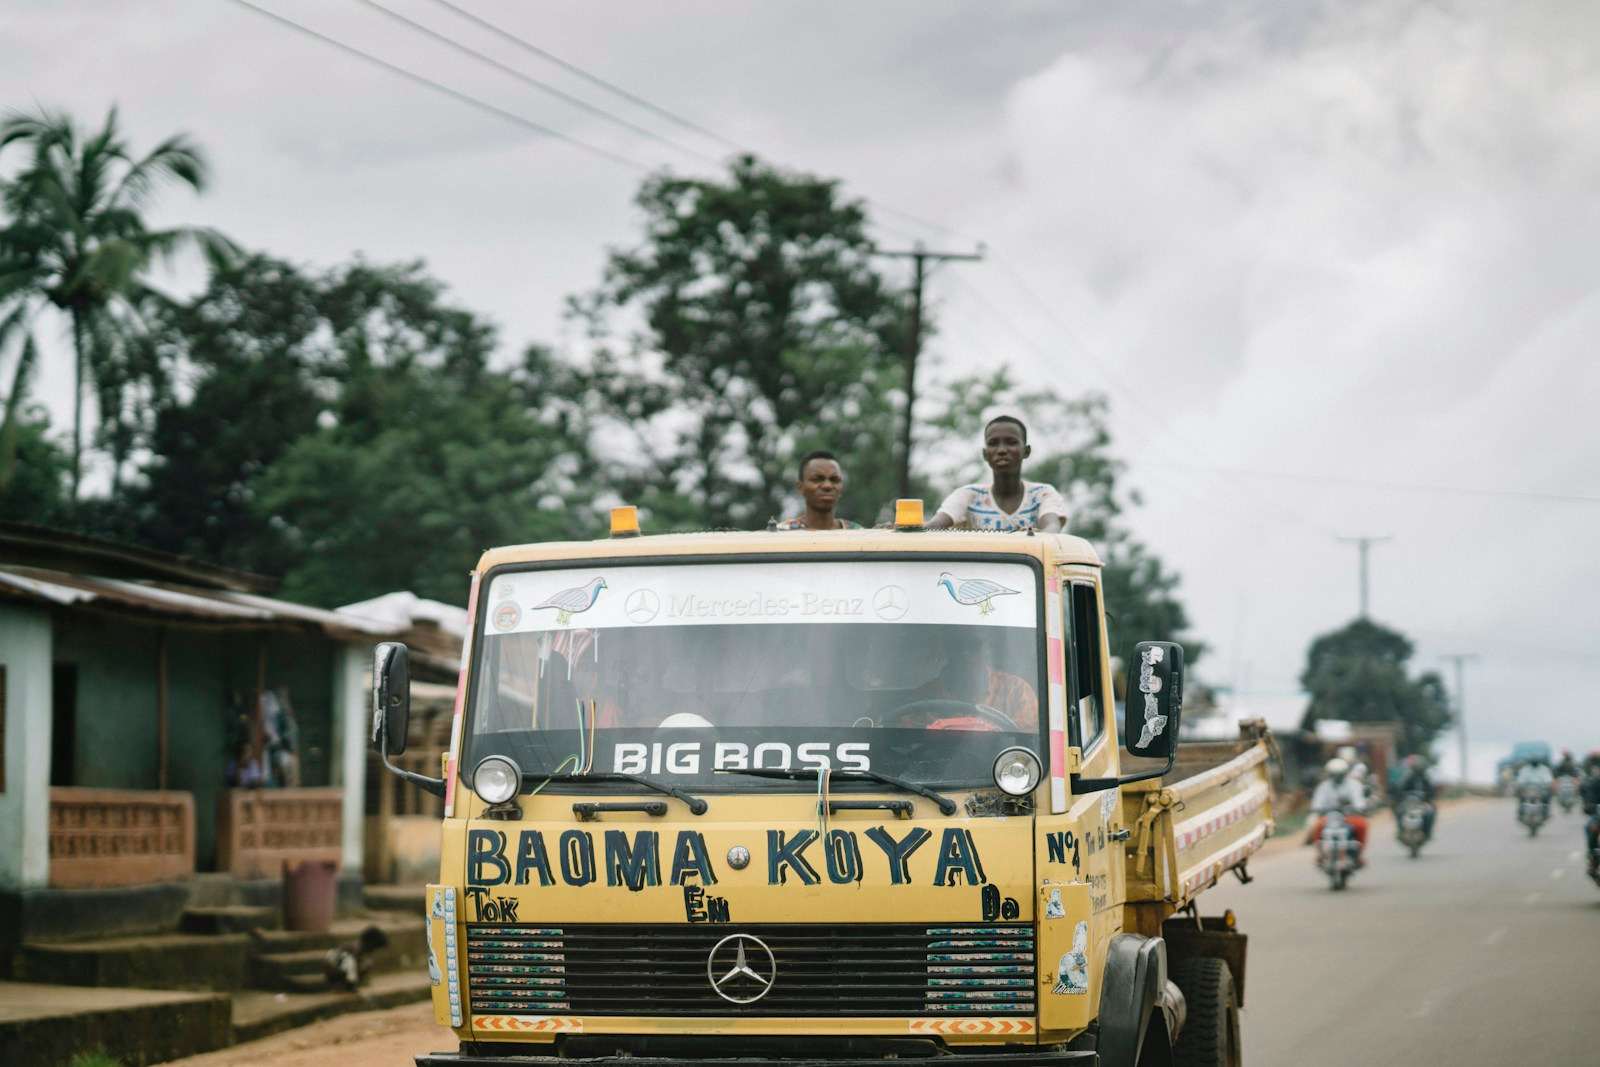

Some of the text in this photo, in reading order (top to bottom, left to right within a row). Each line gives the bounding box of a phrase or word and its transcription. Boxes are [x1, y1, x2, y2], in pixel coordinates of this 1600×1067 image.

[667, 591, 865, 618] Mercedes-Benz
[613, 742, 871, 775] BIG BOSS
[467, 825, 987, 892] BAOMA KOYA
